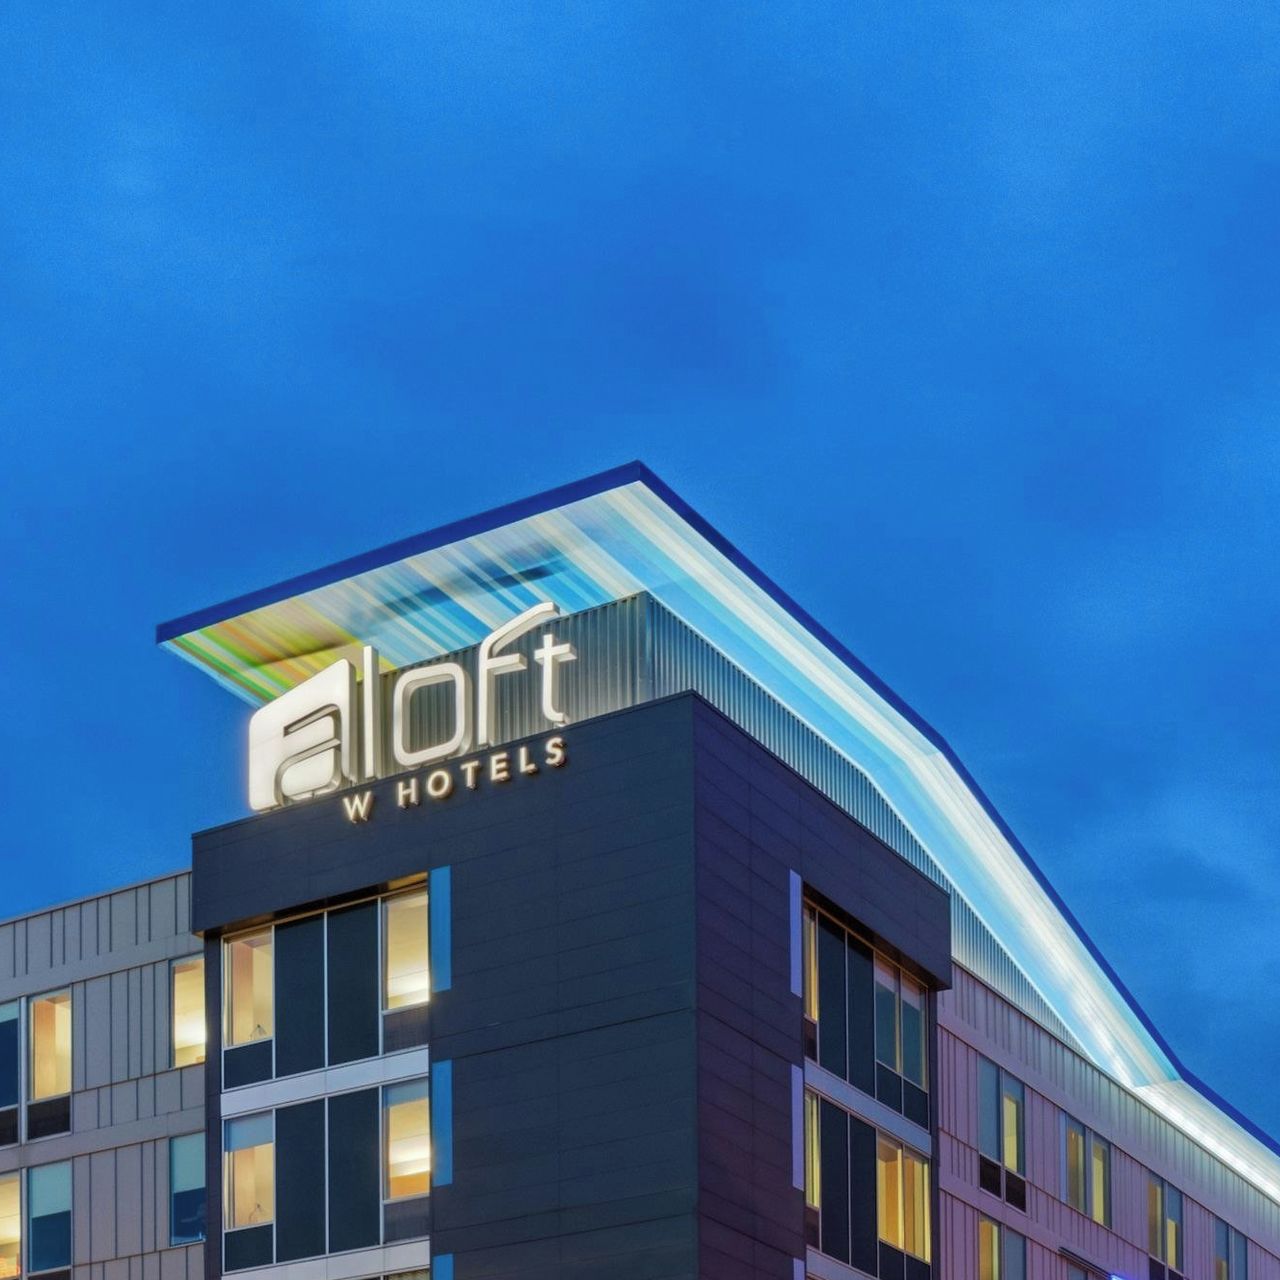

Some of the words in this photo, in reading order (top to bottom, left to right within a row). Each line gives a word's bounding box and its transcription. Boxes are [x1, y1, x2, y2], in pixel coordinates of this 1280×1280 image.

[249, 602, 576, 811] aloft
[343, 791, 373, 823] W
[398, 736, 567, 808] HOTELS
